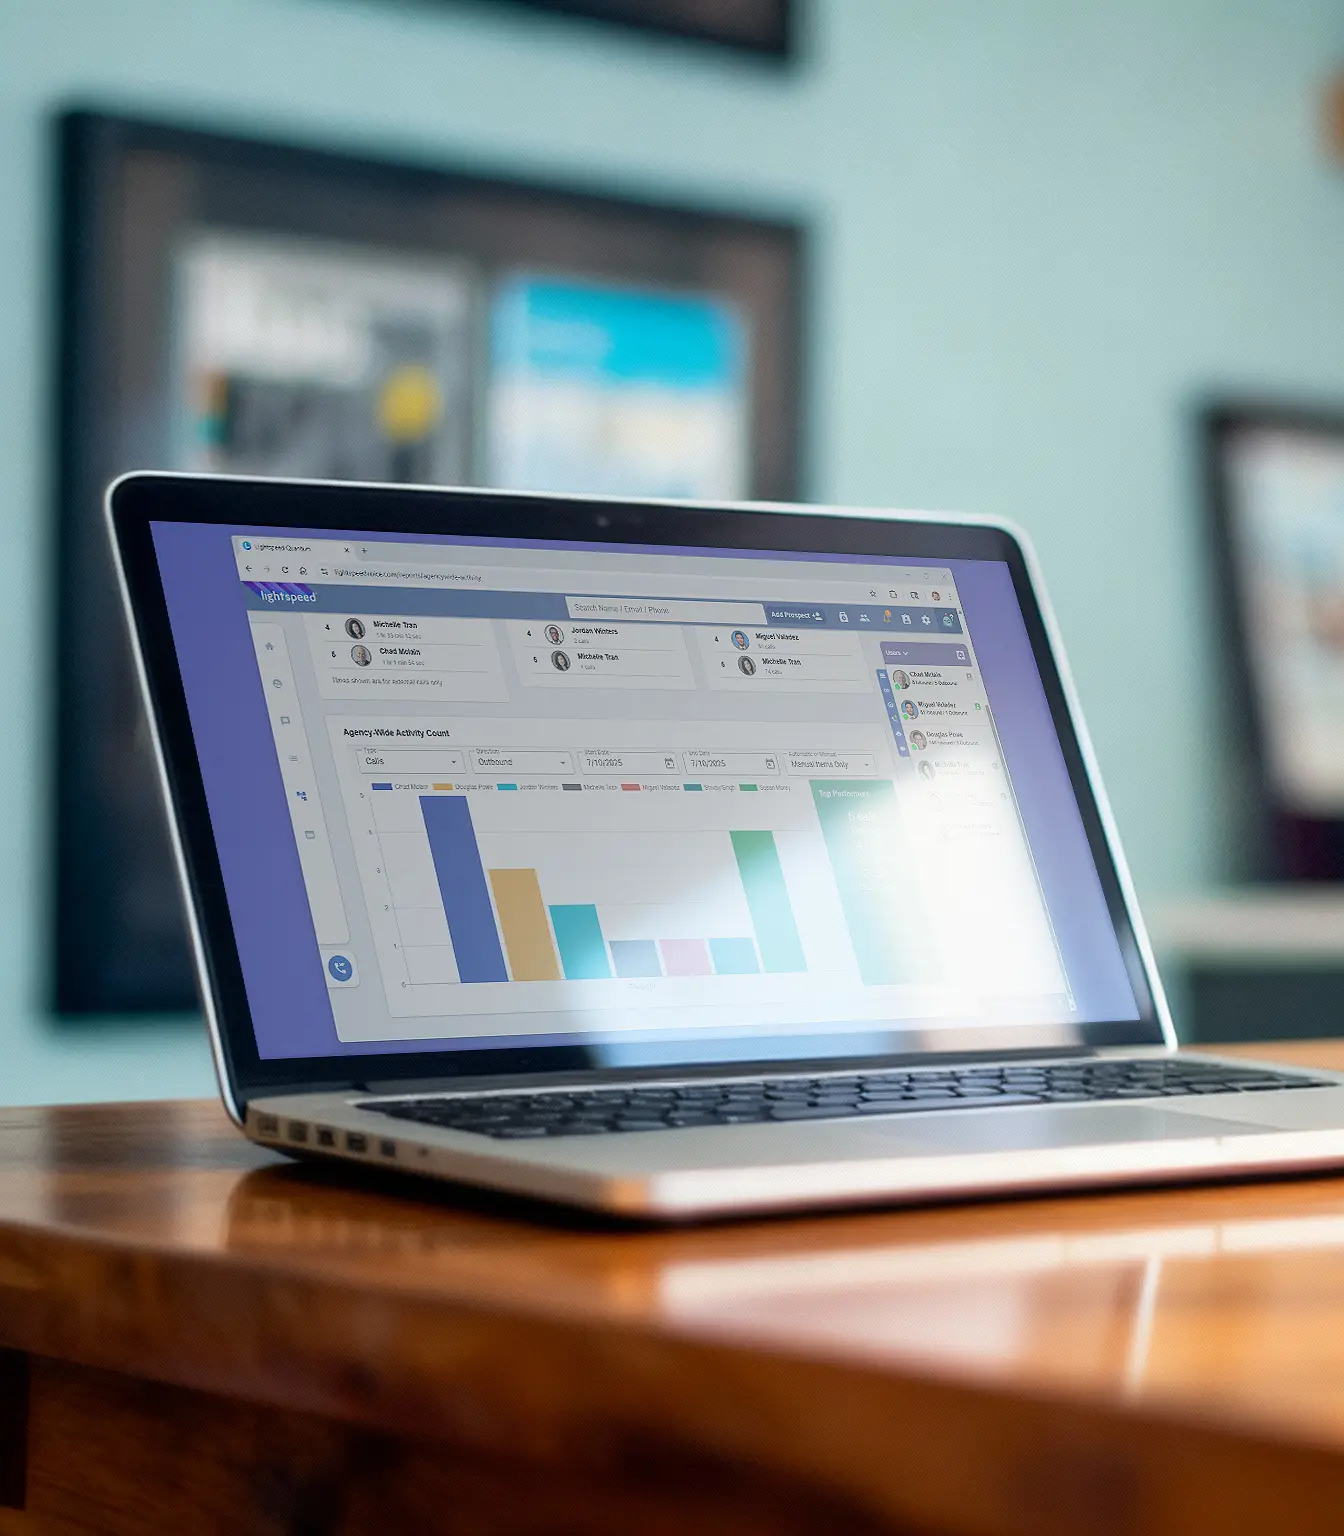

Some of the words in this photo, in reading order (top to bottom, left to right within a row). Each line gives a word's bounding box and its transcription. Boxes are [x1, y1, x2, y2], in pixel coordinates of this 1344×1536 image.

[260, 590, 316, 604] lightspeed
[574, 603, 597, 612] Search
[598, 604, 619, 613] Name
[624, 605, 643, 614] Email
[648, 606, 669, 615] Phone
[784, 611, 811, 620] Prospect
[373, 620, 401, 628] Michelle
[402, 621, 418, 629] Tran
[571, 627, 593, 635] Jordan
[343, 728, 394, 737] Agency-Wide
[396, 728, 424, 738] Activity
[426, 729, 450, 737] Count
[365, 757, 385, 765] Calls
[478, 758, 513, 766] Outbound
[834, 760, 849, 769] Only
